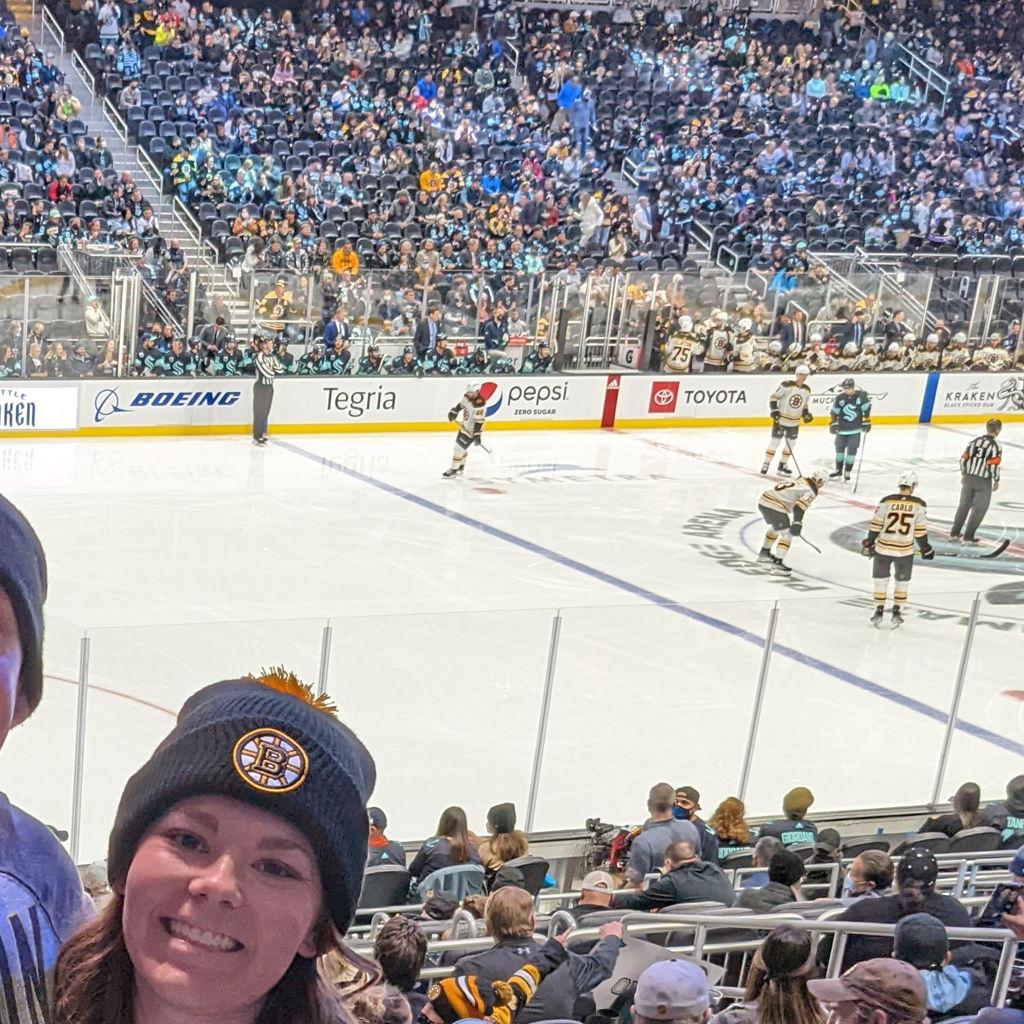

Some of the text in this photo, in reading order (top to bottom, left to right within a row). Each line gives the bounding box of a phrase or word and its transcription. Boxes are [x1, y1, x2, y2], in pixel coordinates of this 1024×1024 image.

[672, 346, 691, 362] 75
[129, 391, 241, 407] BOEING
[323, 386, 397, 417] Tegria
[507, 381, 568, 406] pepsi
[684, 390, 747, 404] TOYOTA
[945, 391, 996, 401] KRAKEN
[891, 503, 914, 512] CARLO
[885, 512, 915, 536] 25
